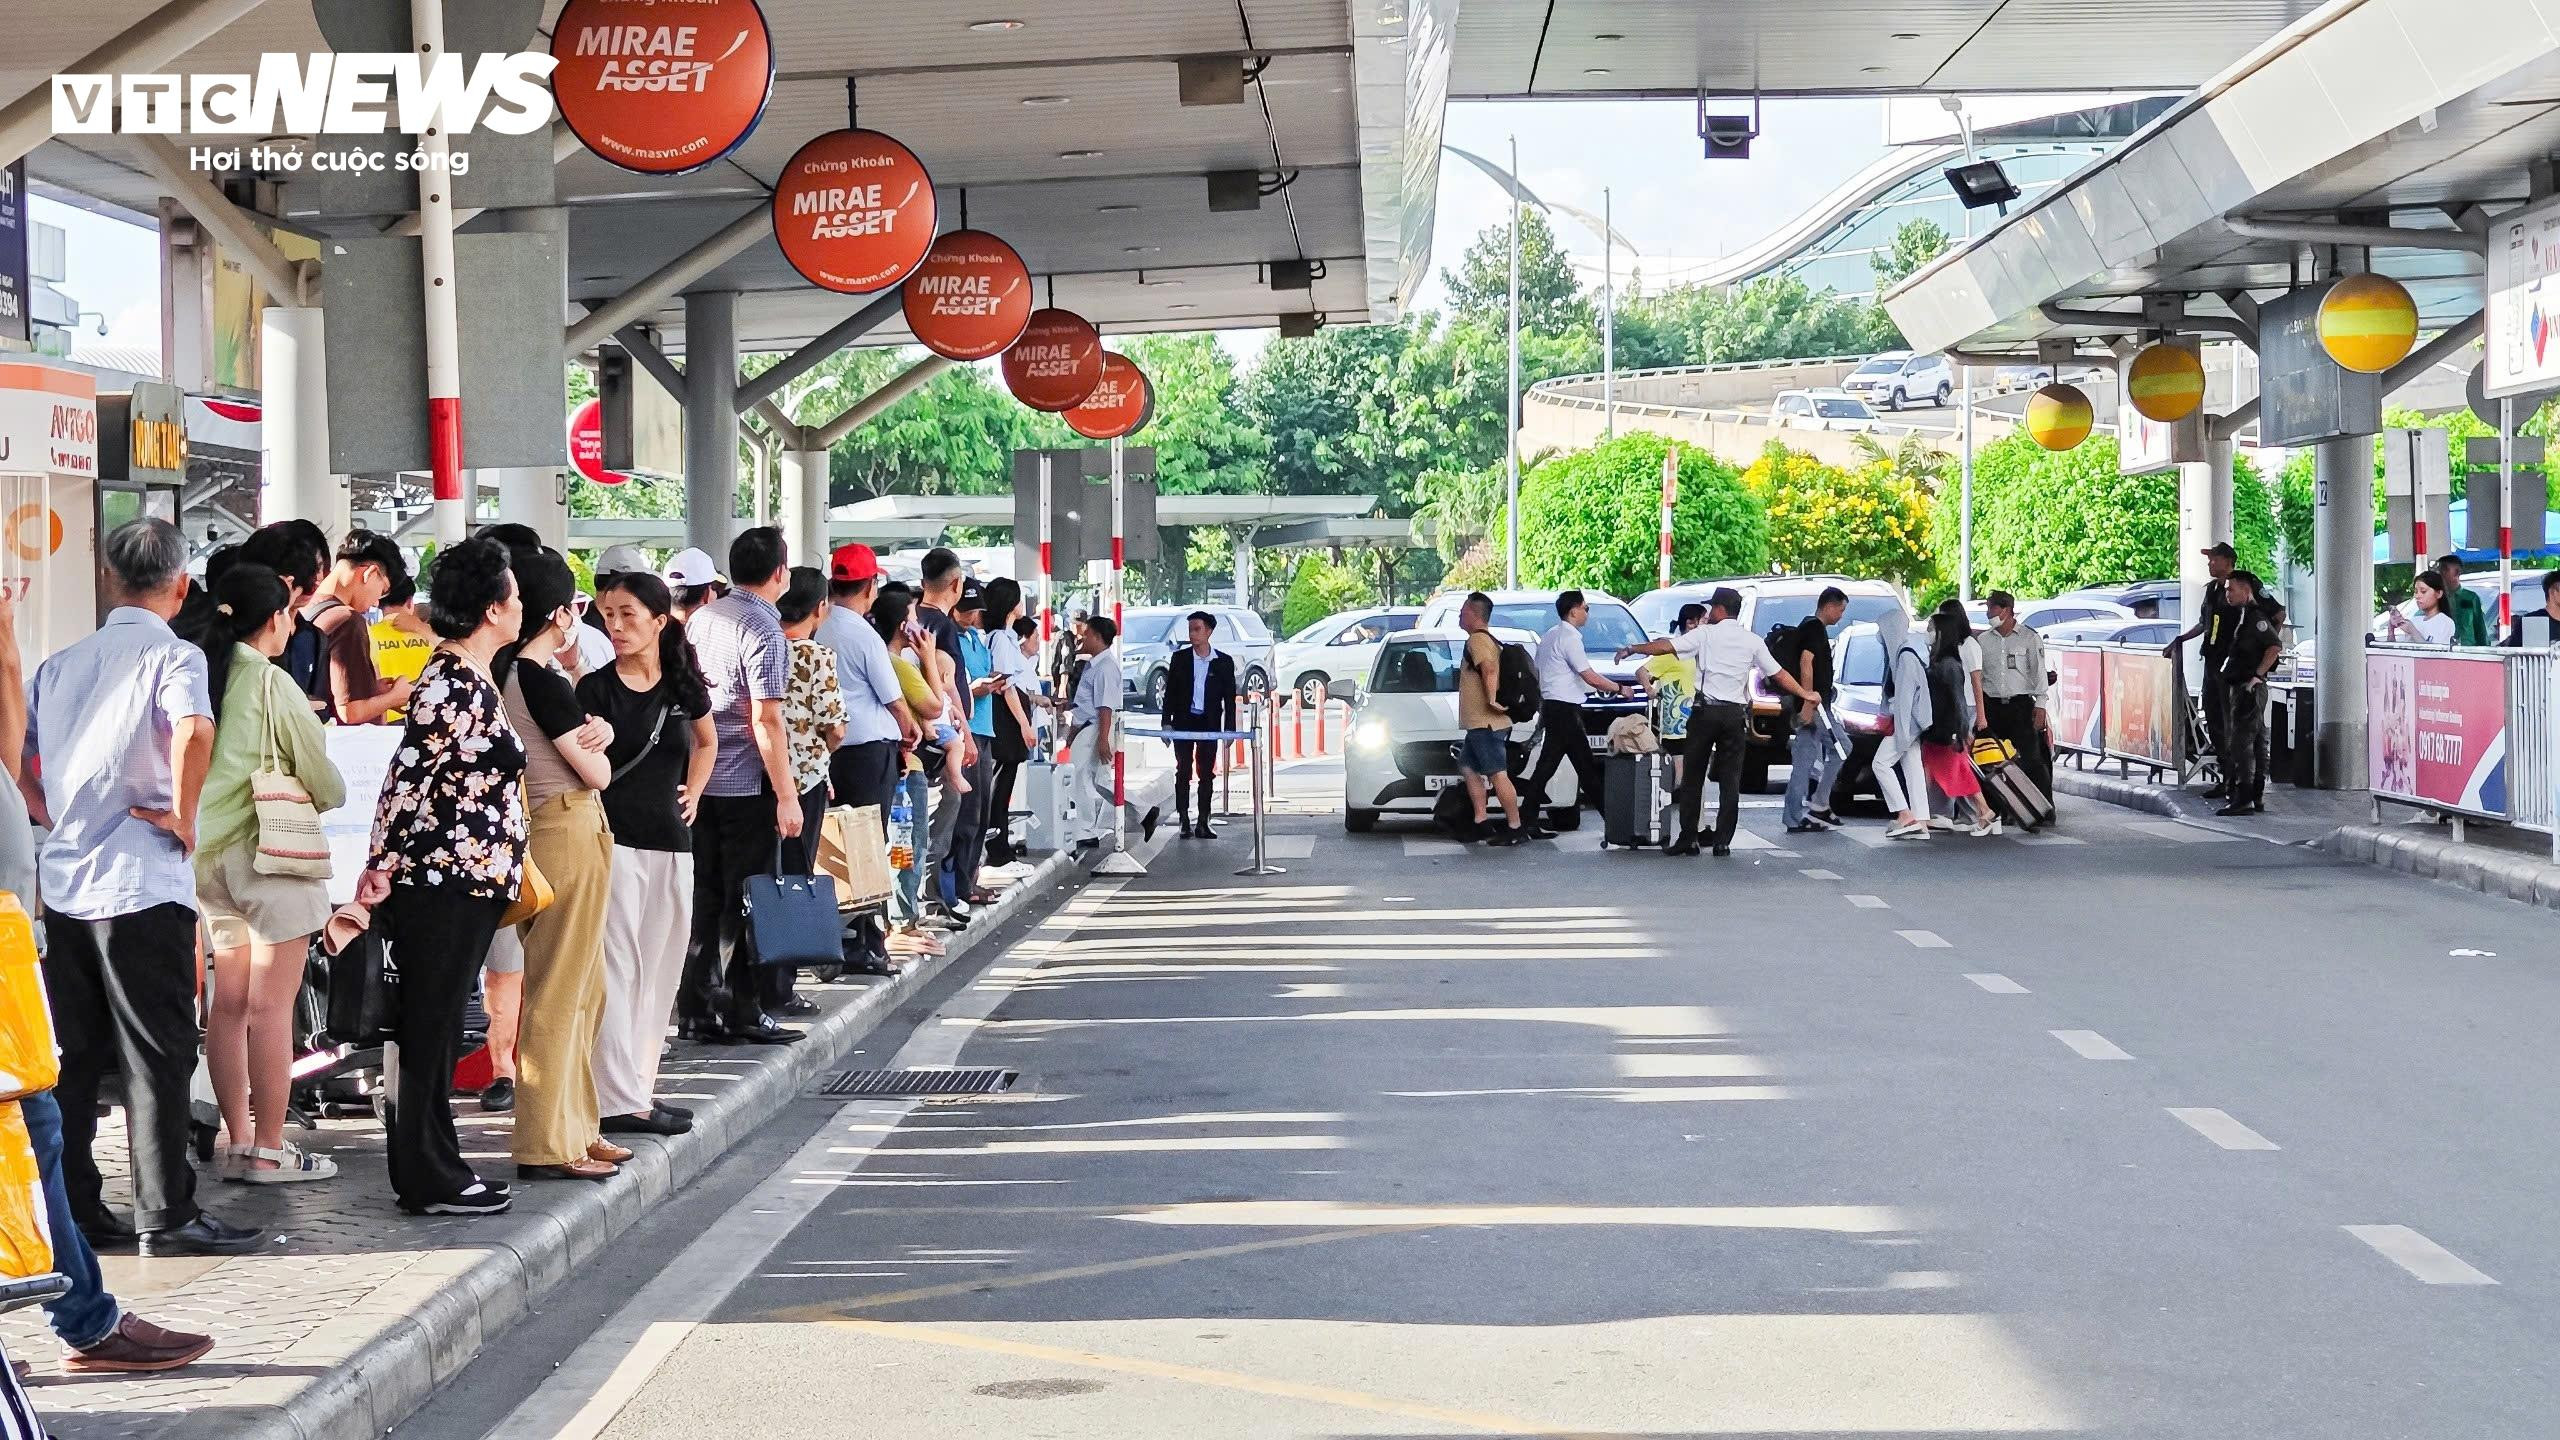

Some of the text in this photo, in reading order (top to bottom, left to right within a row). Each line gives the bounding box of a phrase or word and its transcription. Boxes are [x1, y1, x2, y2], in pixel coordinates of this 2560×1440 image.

[575, 26, 698, 57] MIRAE
[596, 60, 714, 92] ASSET
[600, 134, 709, 159] www.masvn.com
[804, 154, 895, 173] Chứng Khoán
[793, 184, 882, 216] MIRAE
[812, 209, 897, 240] ASSET
[819, 263, 901, 285] www.masvn.com
[918, 275, 991, 295] MIRAE
[0, 292, 18, 318] 394
[931, 296, 1002, 316] ASSET
[1015, 344, 1071, 362] MIRAE
[1026, 359, 1080, 378] ASSET
[1079, 394, 1127, 410] ASSET
[378, 639, 430, 650] HAI VAN
